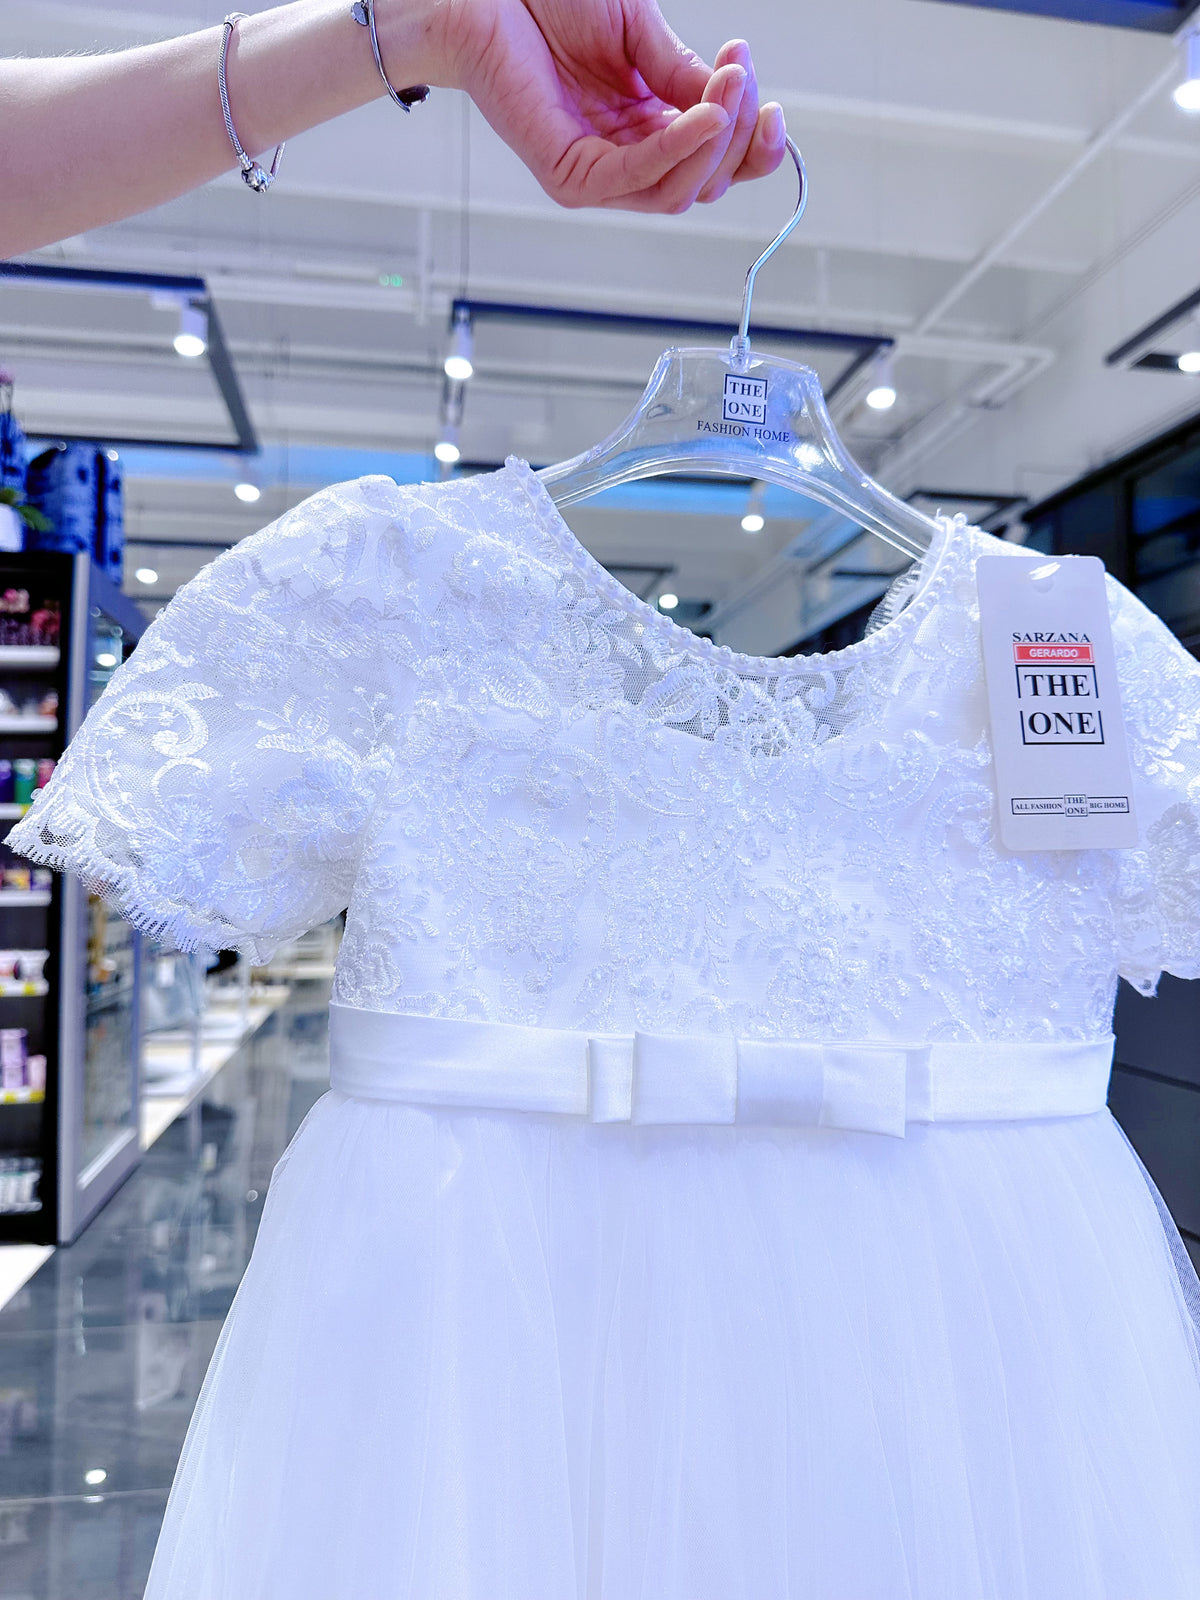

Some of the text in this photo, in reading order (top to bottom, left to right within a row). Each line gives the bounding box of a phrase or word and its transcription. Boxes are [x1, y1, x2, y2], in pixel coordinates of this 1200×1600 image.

[729, 381, 763, 398] THE
[728, 401, 762, 418] ONE
[697, 420, 790, 442] FASHION HOME
[1012, 632, 1091, 643] SARZANA
[1029, 648, 1079, 658] GERARDO
[1024, 674, 1090, 697] THE
[1028, 711, 1096, 735] ONE
